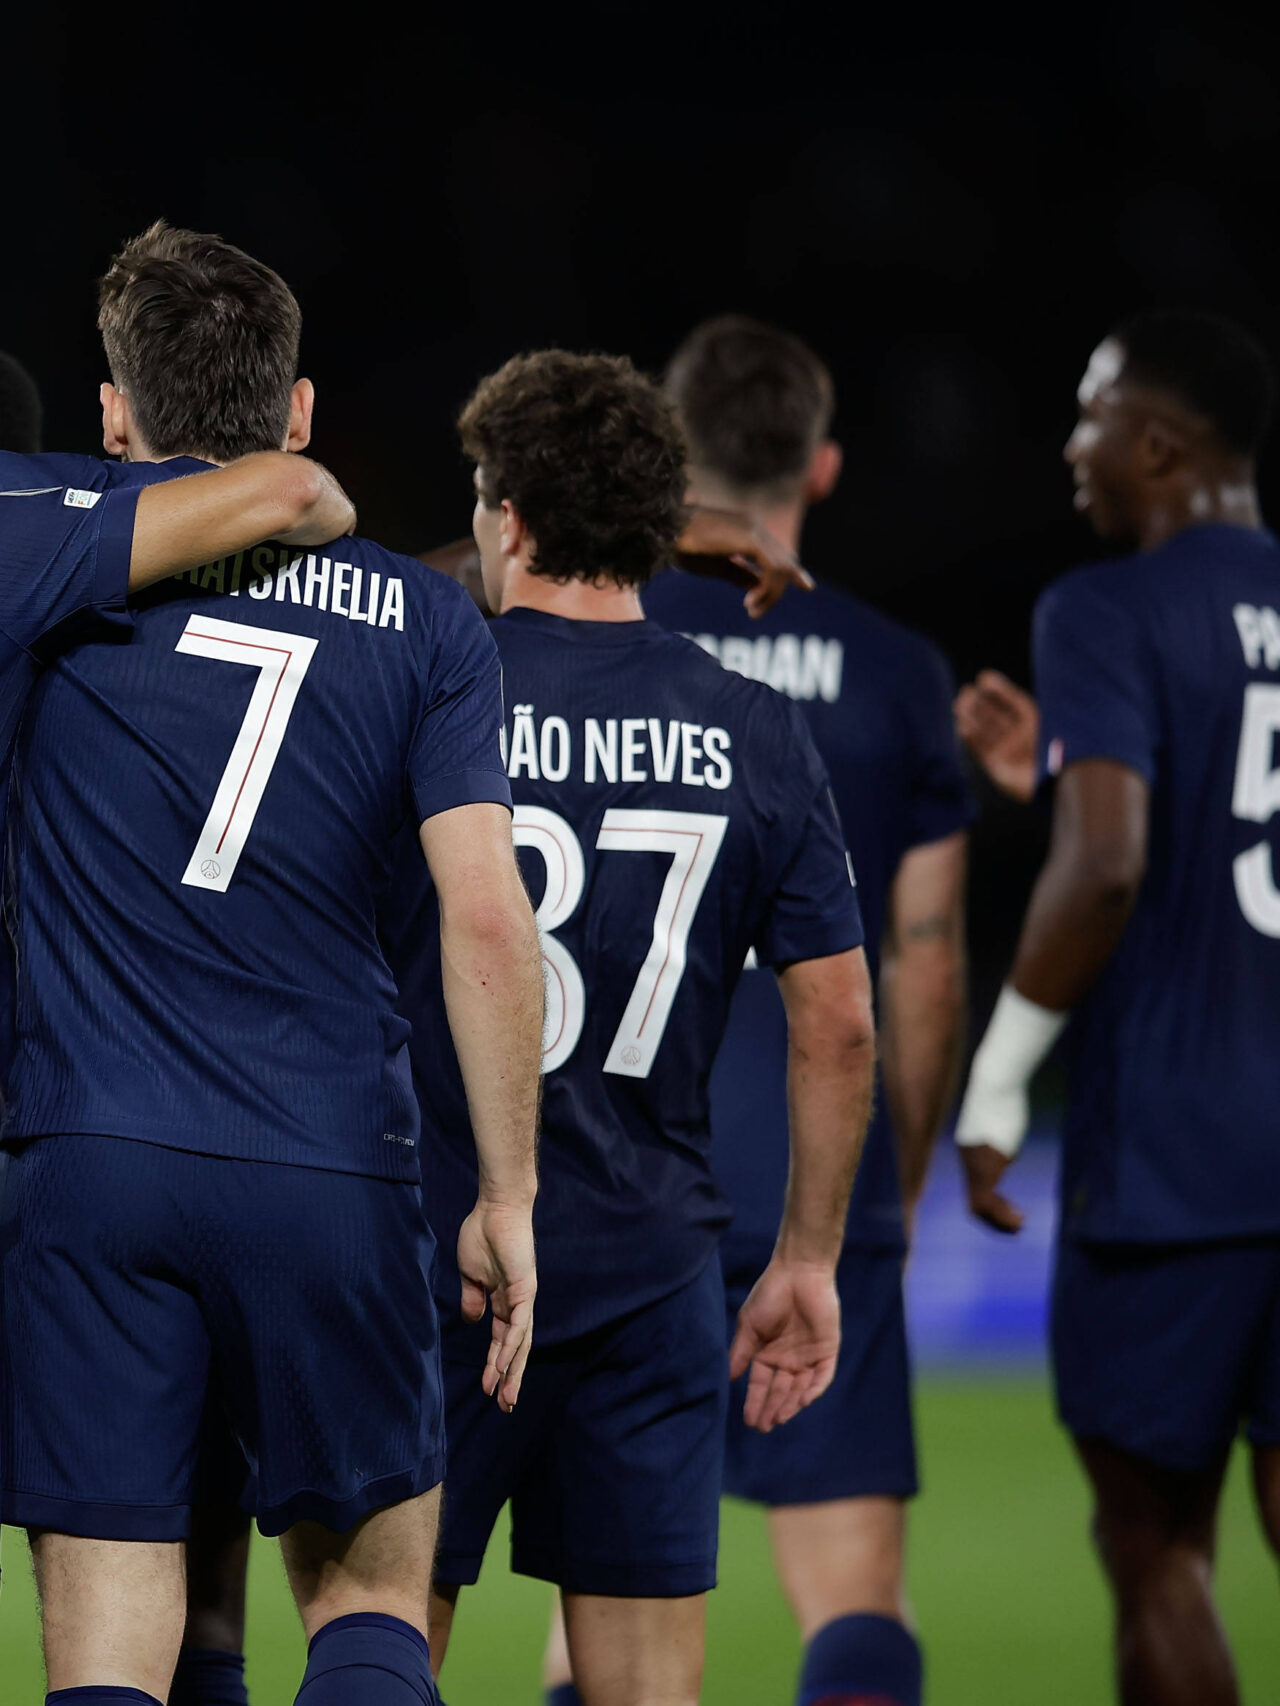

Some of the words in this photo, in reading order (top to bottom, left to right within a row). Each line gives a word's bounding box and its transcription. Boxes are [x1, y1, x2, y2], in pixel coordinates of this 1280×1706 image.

[174, 613, 320, 893] 7
[501, 704, 570, 782] ÃO
[584, 717, 733, 790] NEVES
